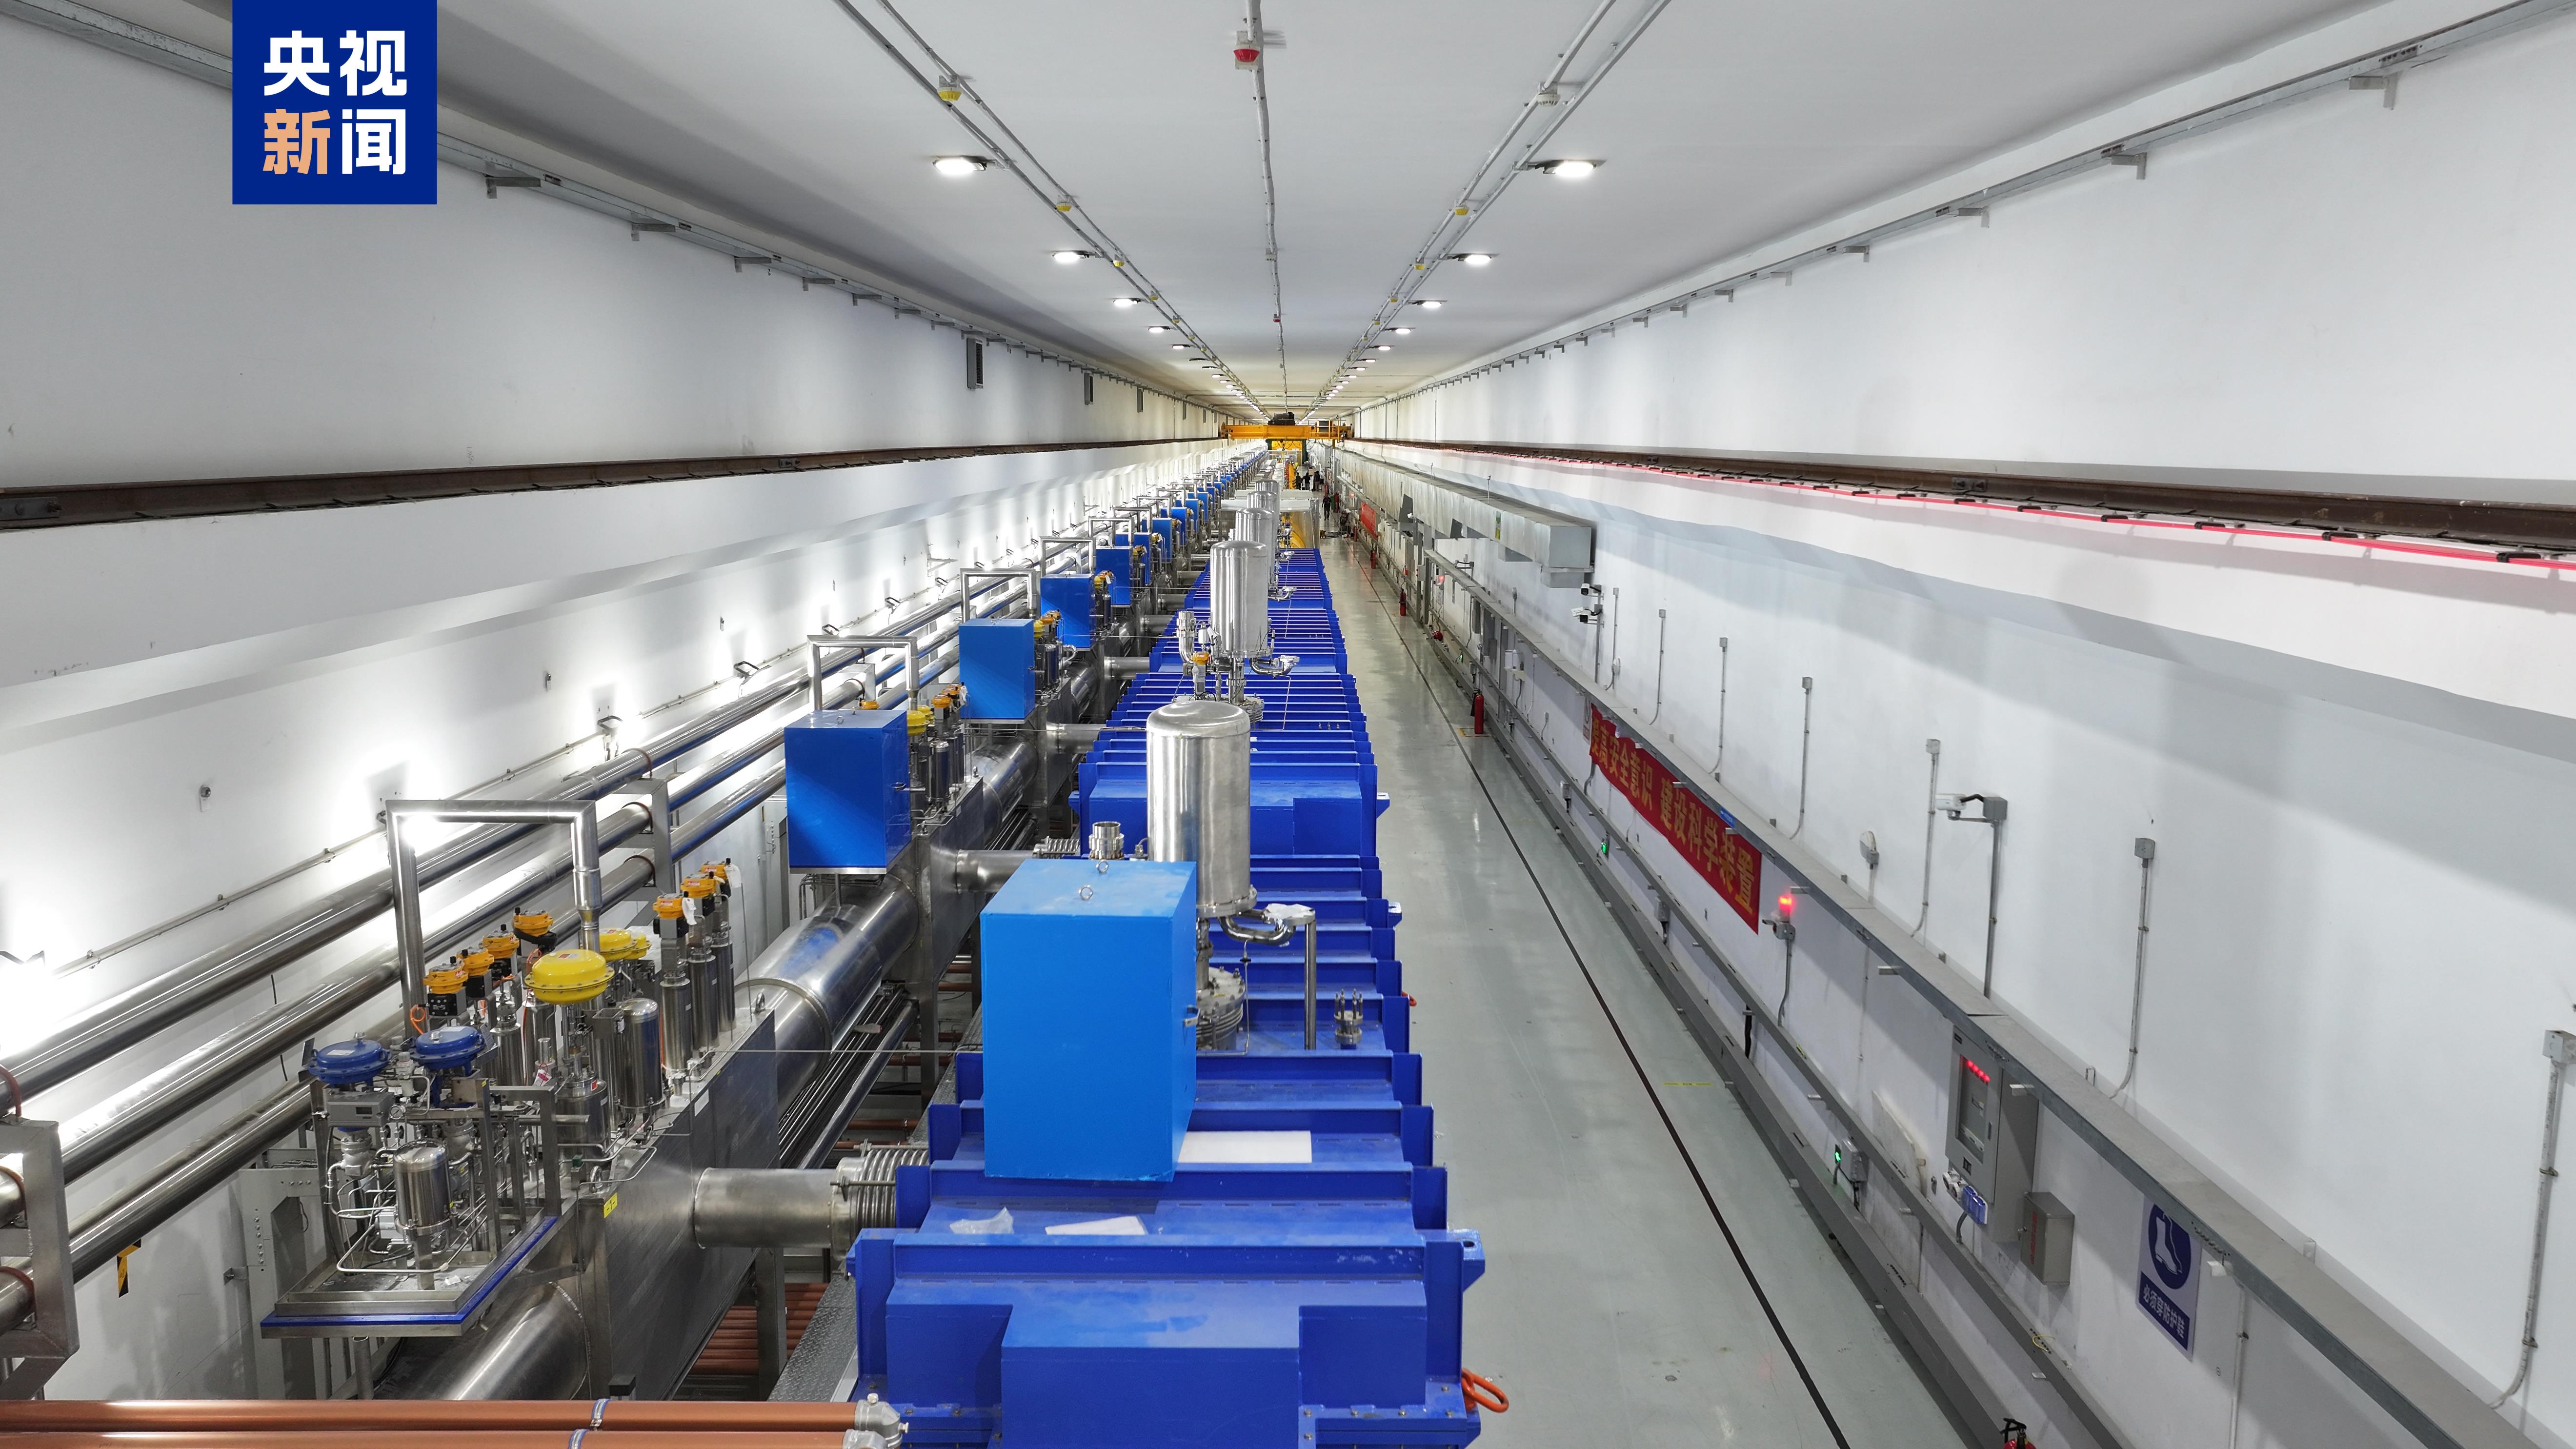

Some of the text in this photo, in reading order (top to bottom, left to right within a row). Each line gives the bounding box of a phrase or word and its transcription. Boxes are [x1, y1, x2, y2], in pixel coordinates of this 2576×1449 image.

[1660, 777, 1755, 914] 建设科学装置
[2143, 1284, 2185, 1339] 必须穿防护鞋
